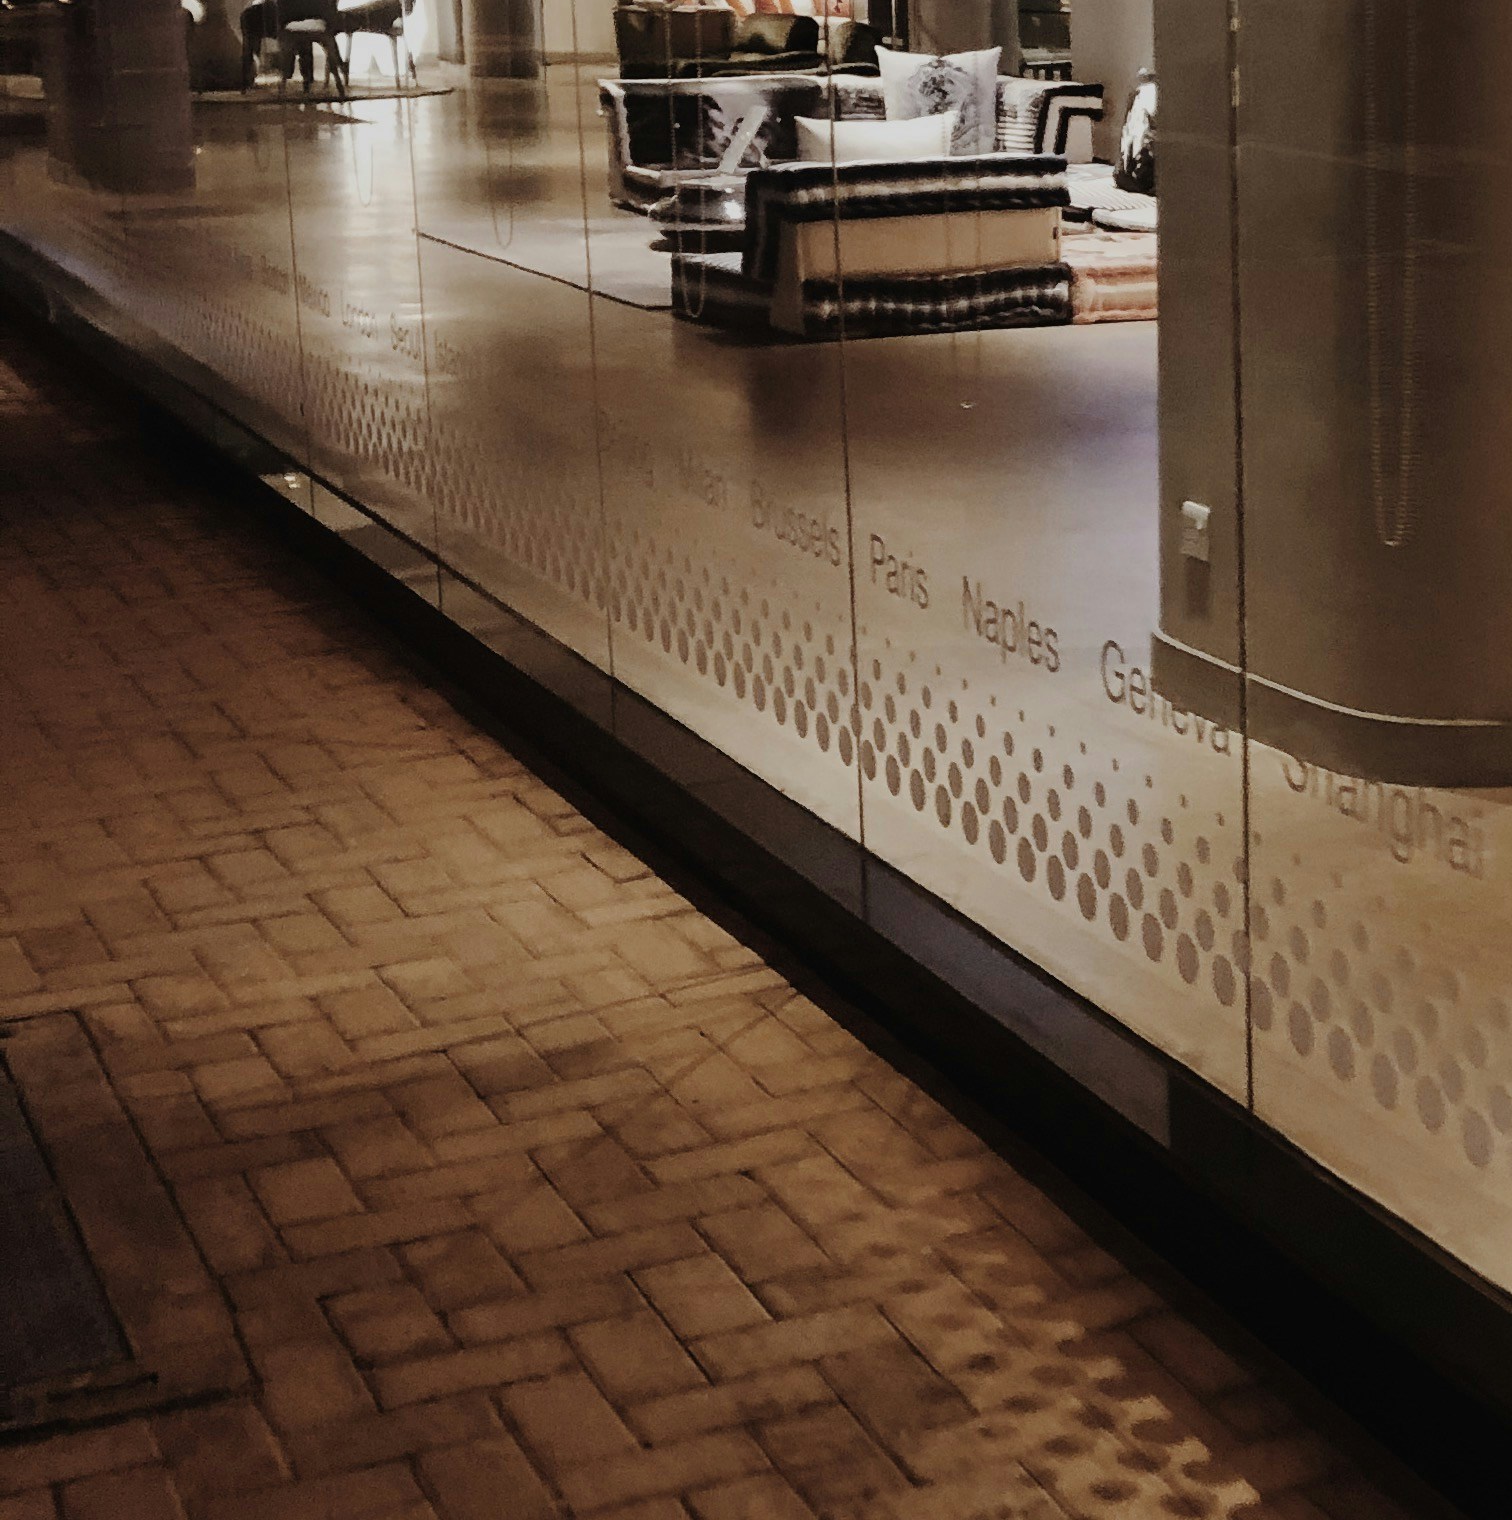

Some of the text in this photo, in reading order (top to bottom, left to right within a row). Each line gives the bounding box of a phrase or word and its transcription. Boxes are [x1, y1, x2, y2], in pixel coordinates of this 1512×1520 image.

[750, 478, 842, 568] Brussels
[869, 532, 930, 610] Paris
[961, 574, 1060, 673] Naples
